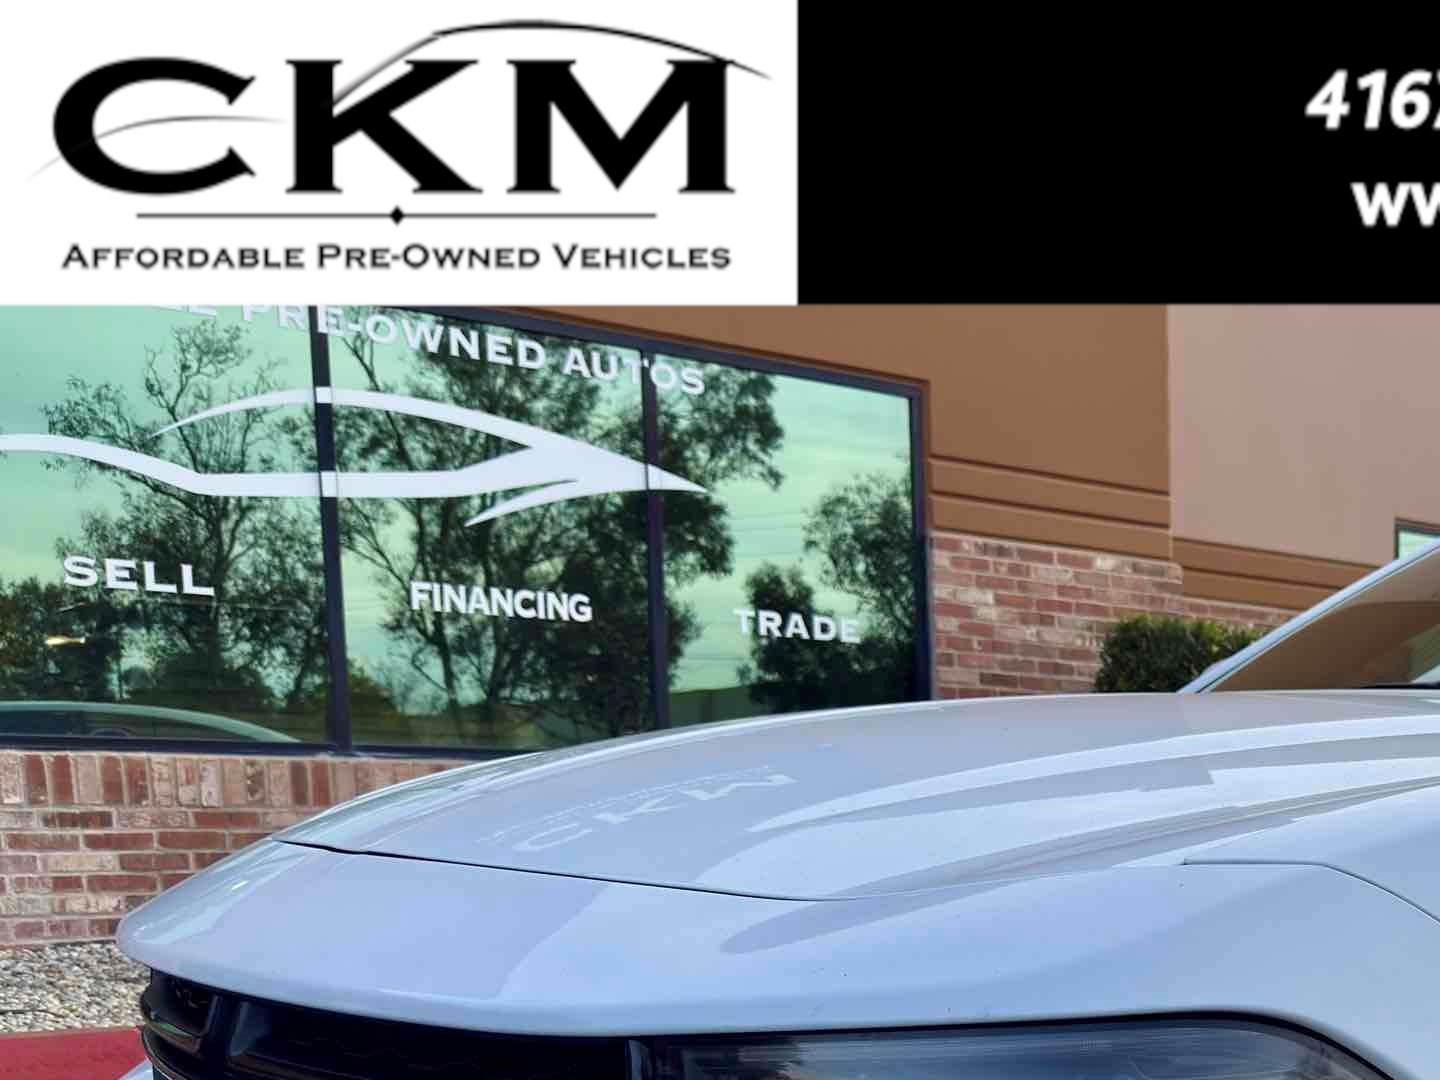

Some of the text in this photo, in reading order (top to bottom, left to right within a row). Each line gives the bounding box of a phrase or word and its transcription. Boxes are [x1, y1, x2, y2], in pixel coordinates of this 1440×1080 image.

[562, 346, 706, 395] AUTOS
[63, 555, 215, 597] SELL
[409, 580, 593, 623] FINANCING
[733, 608, 863, 645] TRADE
